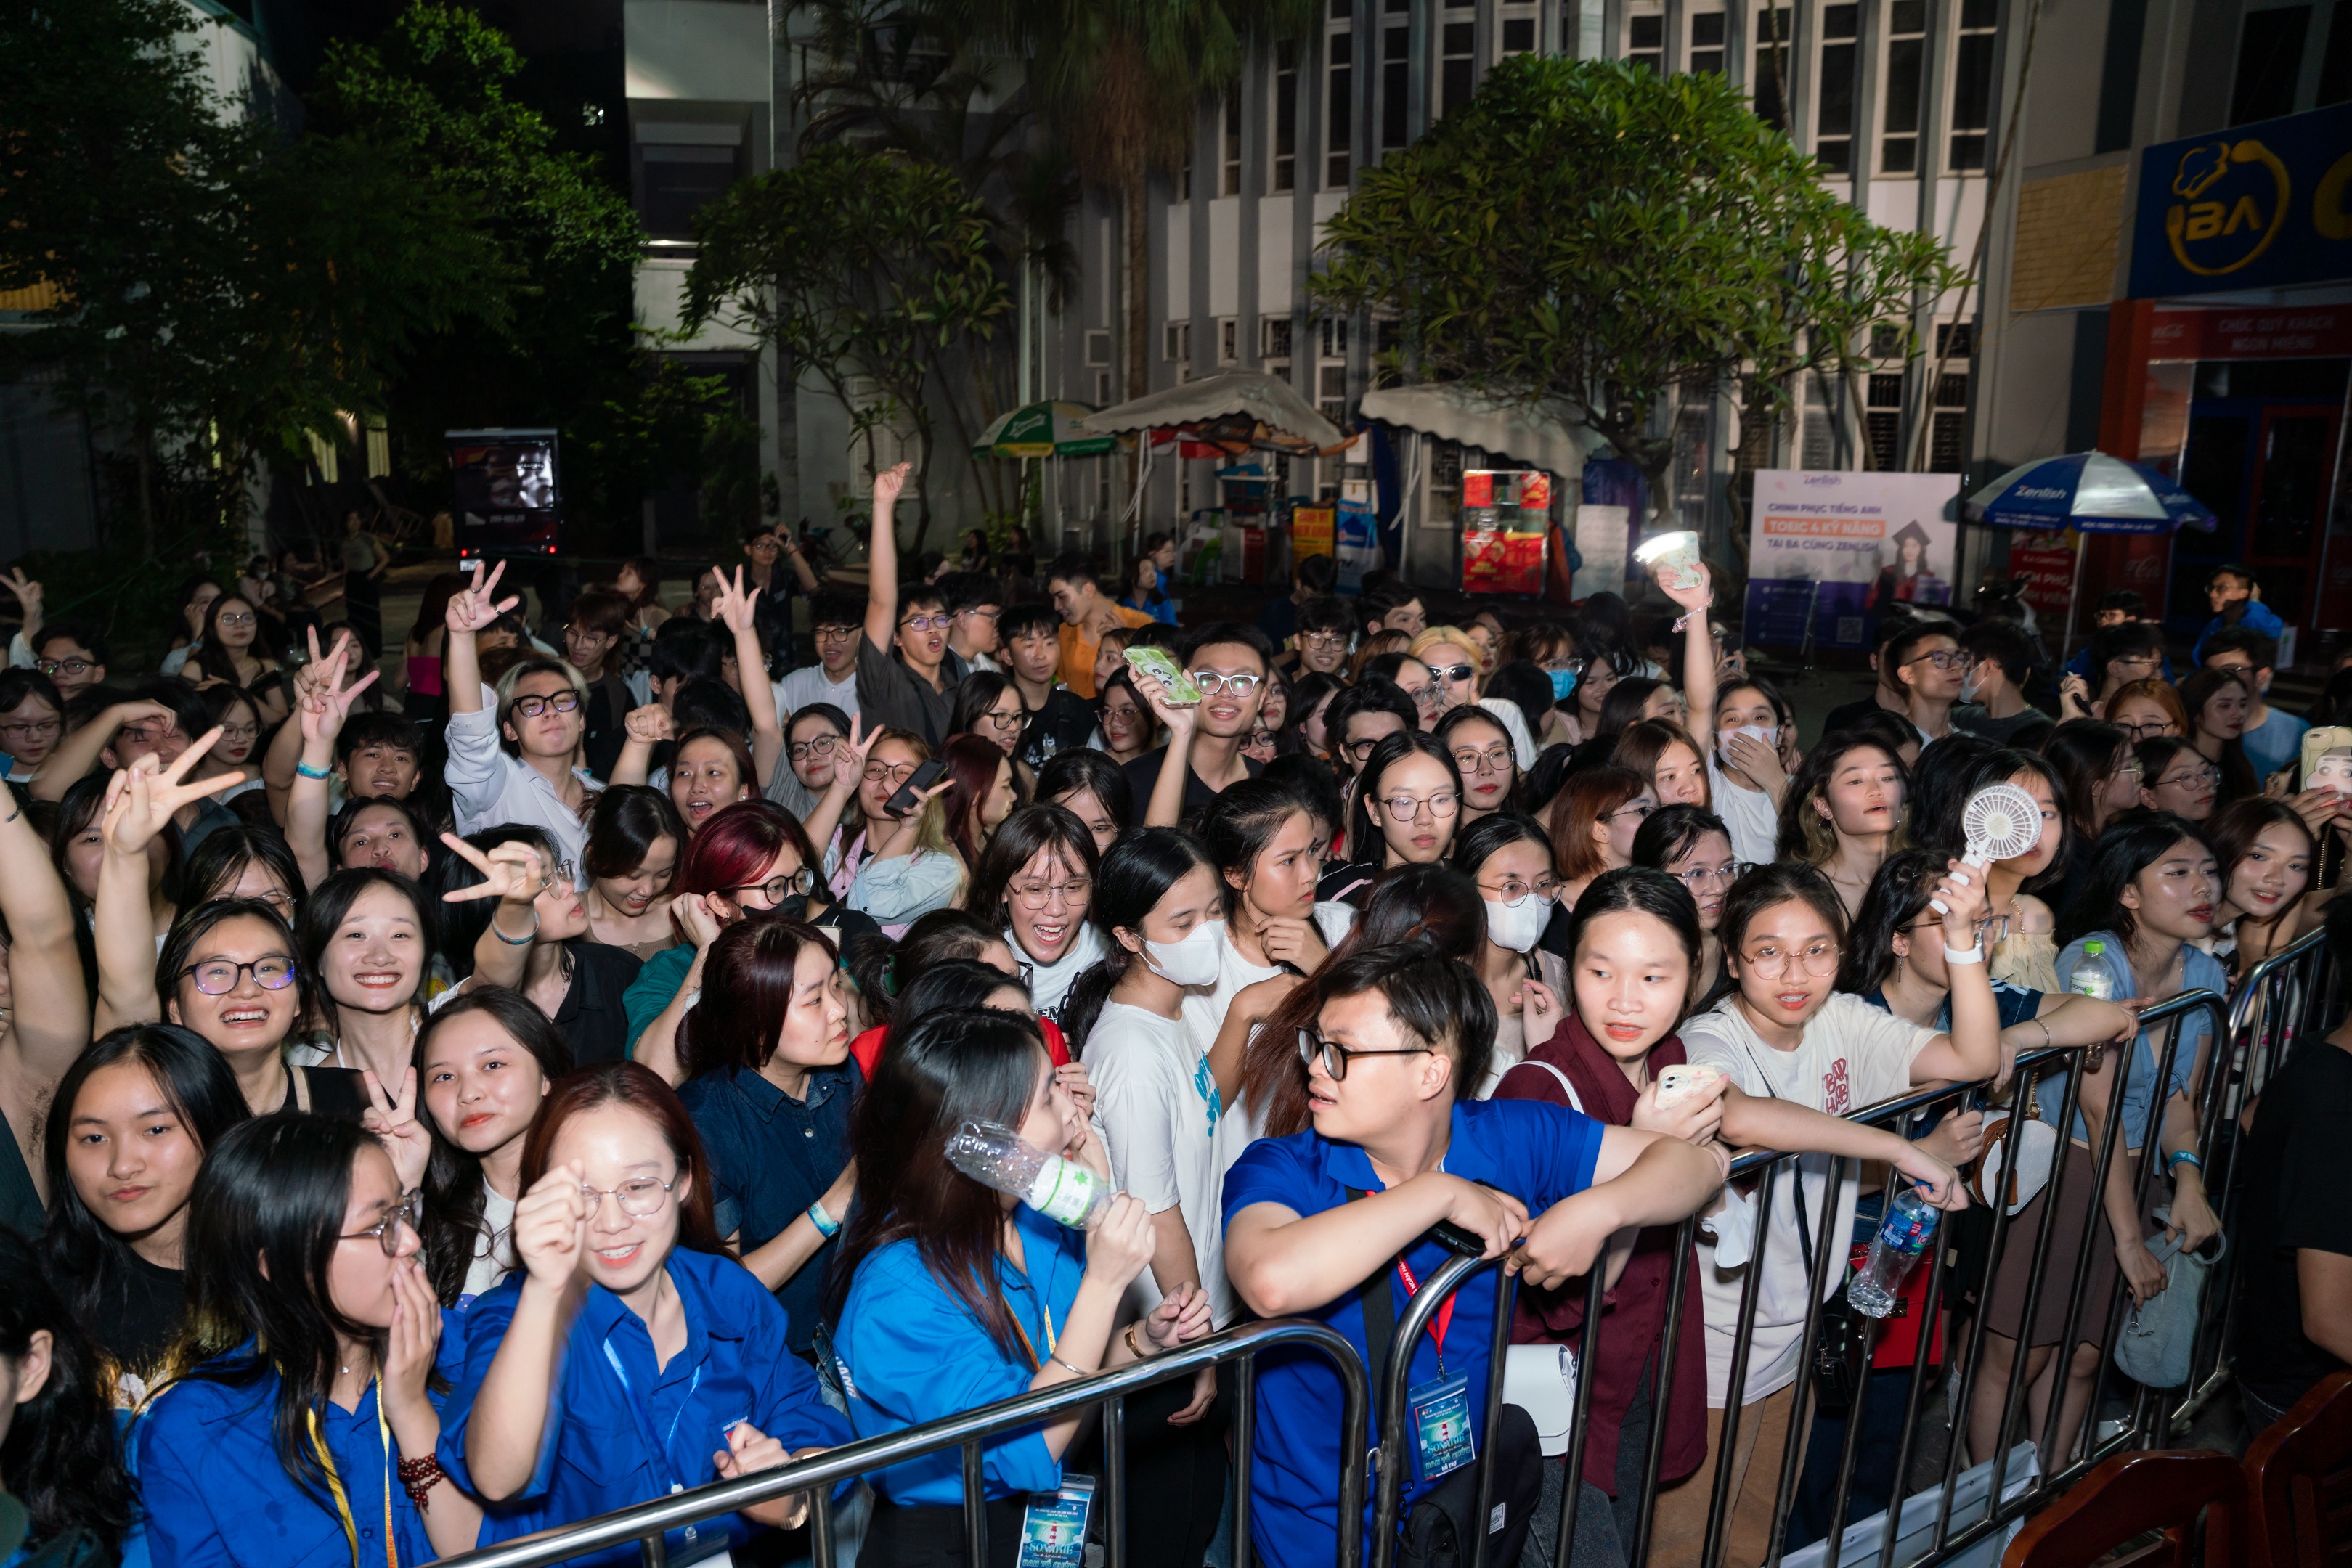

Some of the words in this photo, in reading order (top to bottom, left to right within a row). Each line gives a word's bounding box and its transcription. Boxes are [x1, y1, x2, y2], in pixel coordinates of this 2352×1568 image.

[2014, 483, 2067, 501] Zenlish
[1830, 501, 1859, 514] TIẾNG
[1860, 505, 1883, 514] ANH
[1768, 520, 1808, 533] TOEIC
[1810, 521, 1820, 533] 4
[1820, 519, 1839, 534] KỸ
[1842, 520, 1881, 536] NĂNG
[1767, 539, 1783, 552] TẠI
[1785, 539, 1799, 549] BA
[1802, 538, 1834, 550] CÙNG
[1835, 541, 1880, 552] ZENLISH
[1823, 1058, 1847, 1096] BAD
[1022, 1559, 1040, 1567] BAN
[1041, 1559, 1051, 1568] TỔ
